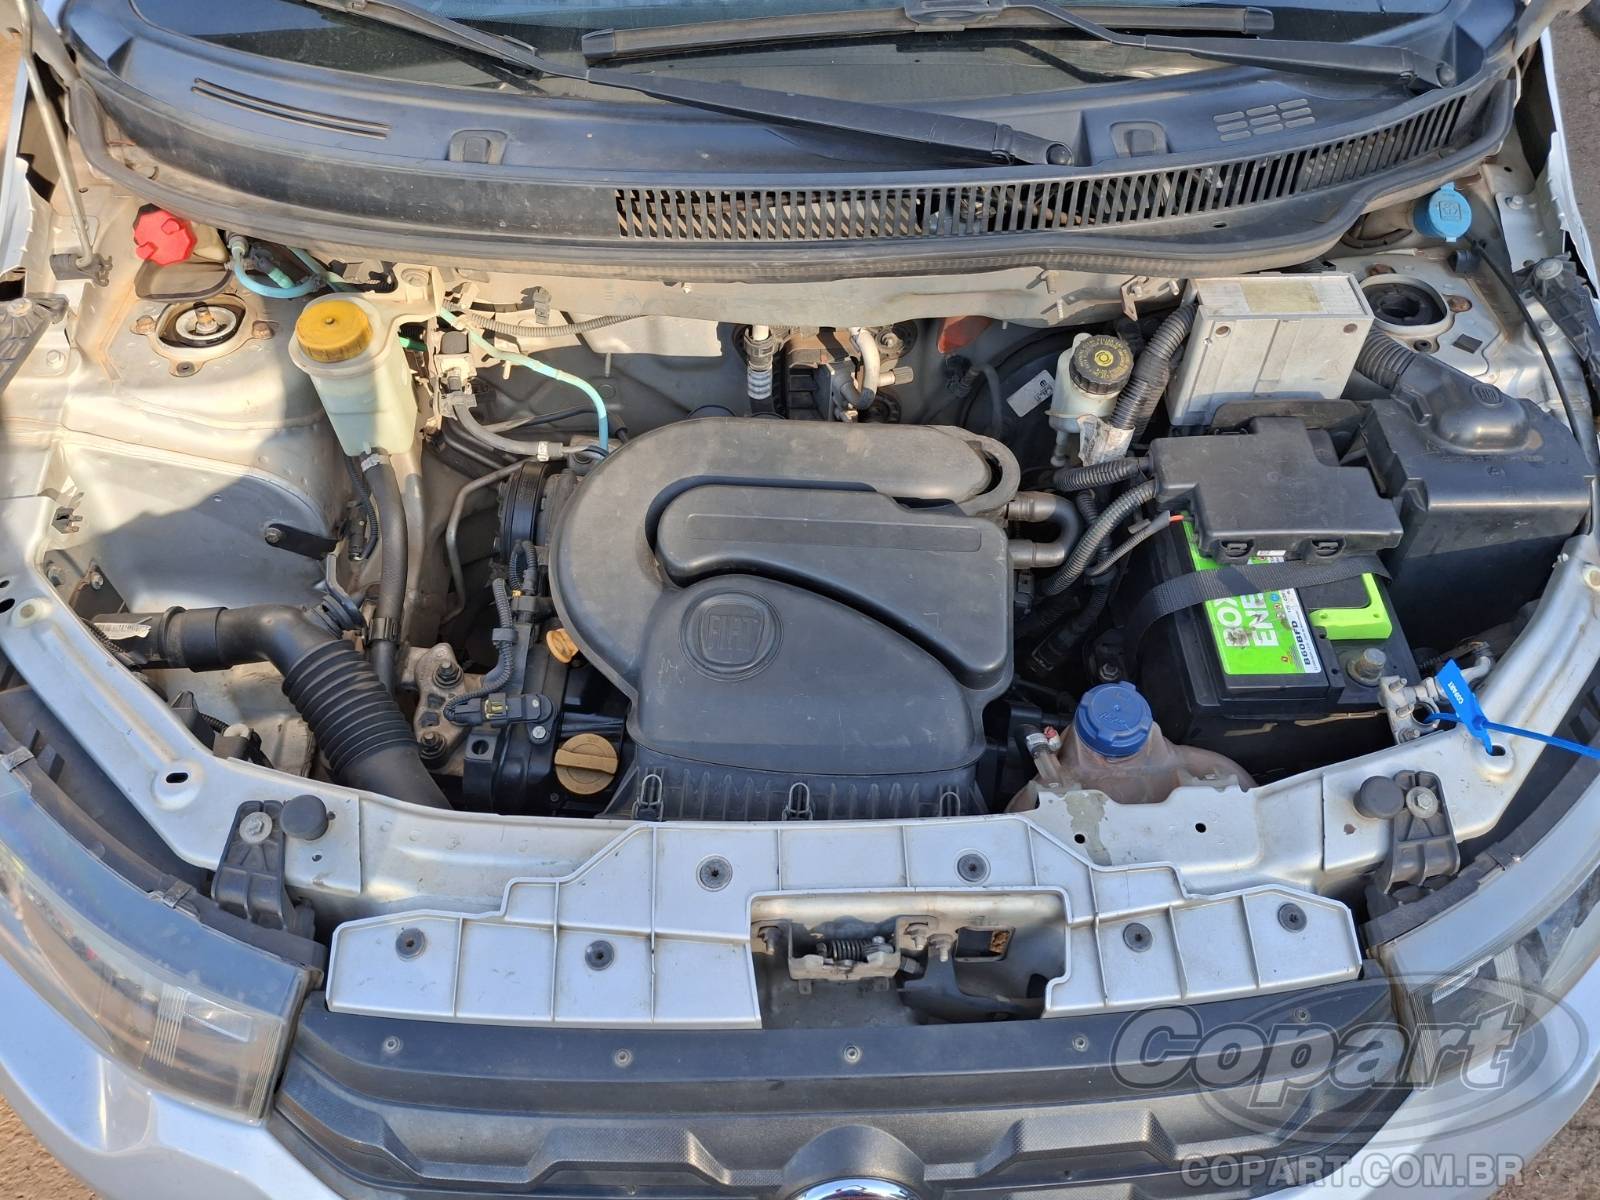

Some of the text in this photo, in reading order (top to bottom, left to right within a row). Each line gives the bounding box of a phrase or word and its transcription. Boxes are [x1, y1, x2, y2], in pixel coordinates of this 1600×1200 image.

[706, 614, 762, 651] FIAT
[1291, 620, 1311, 666] B60BFD
[1447, 680, 1464, 705] COPART
